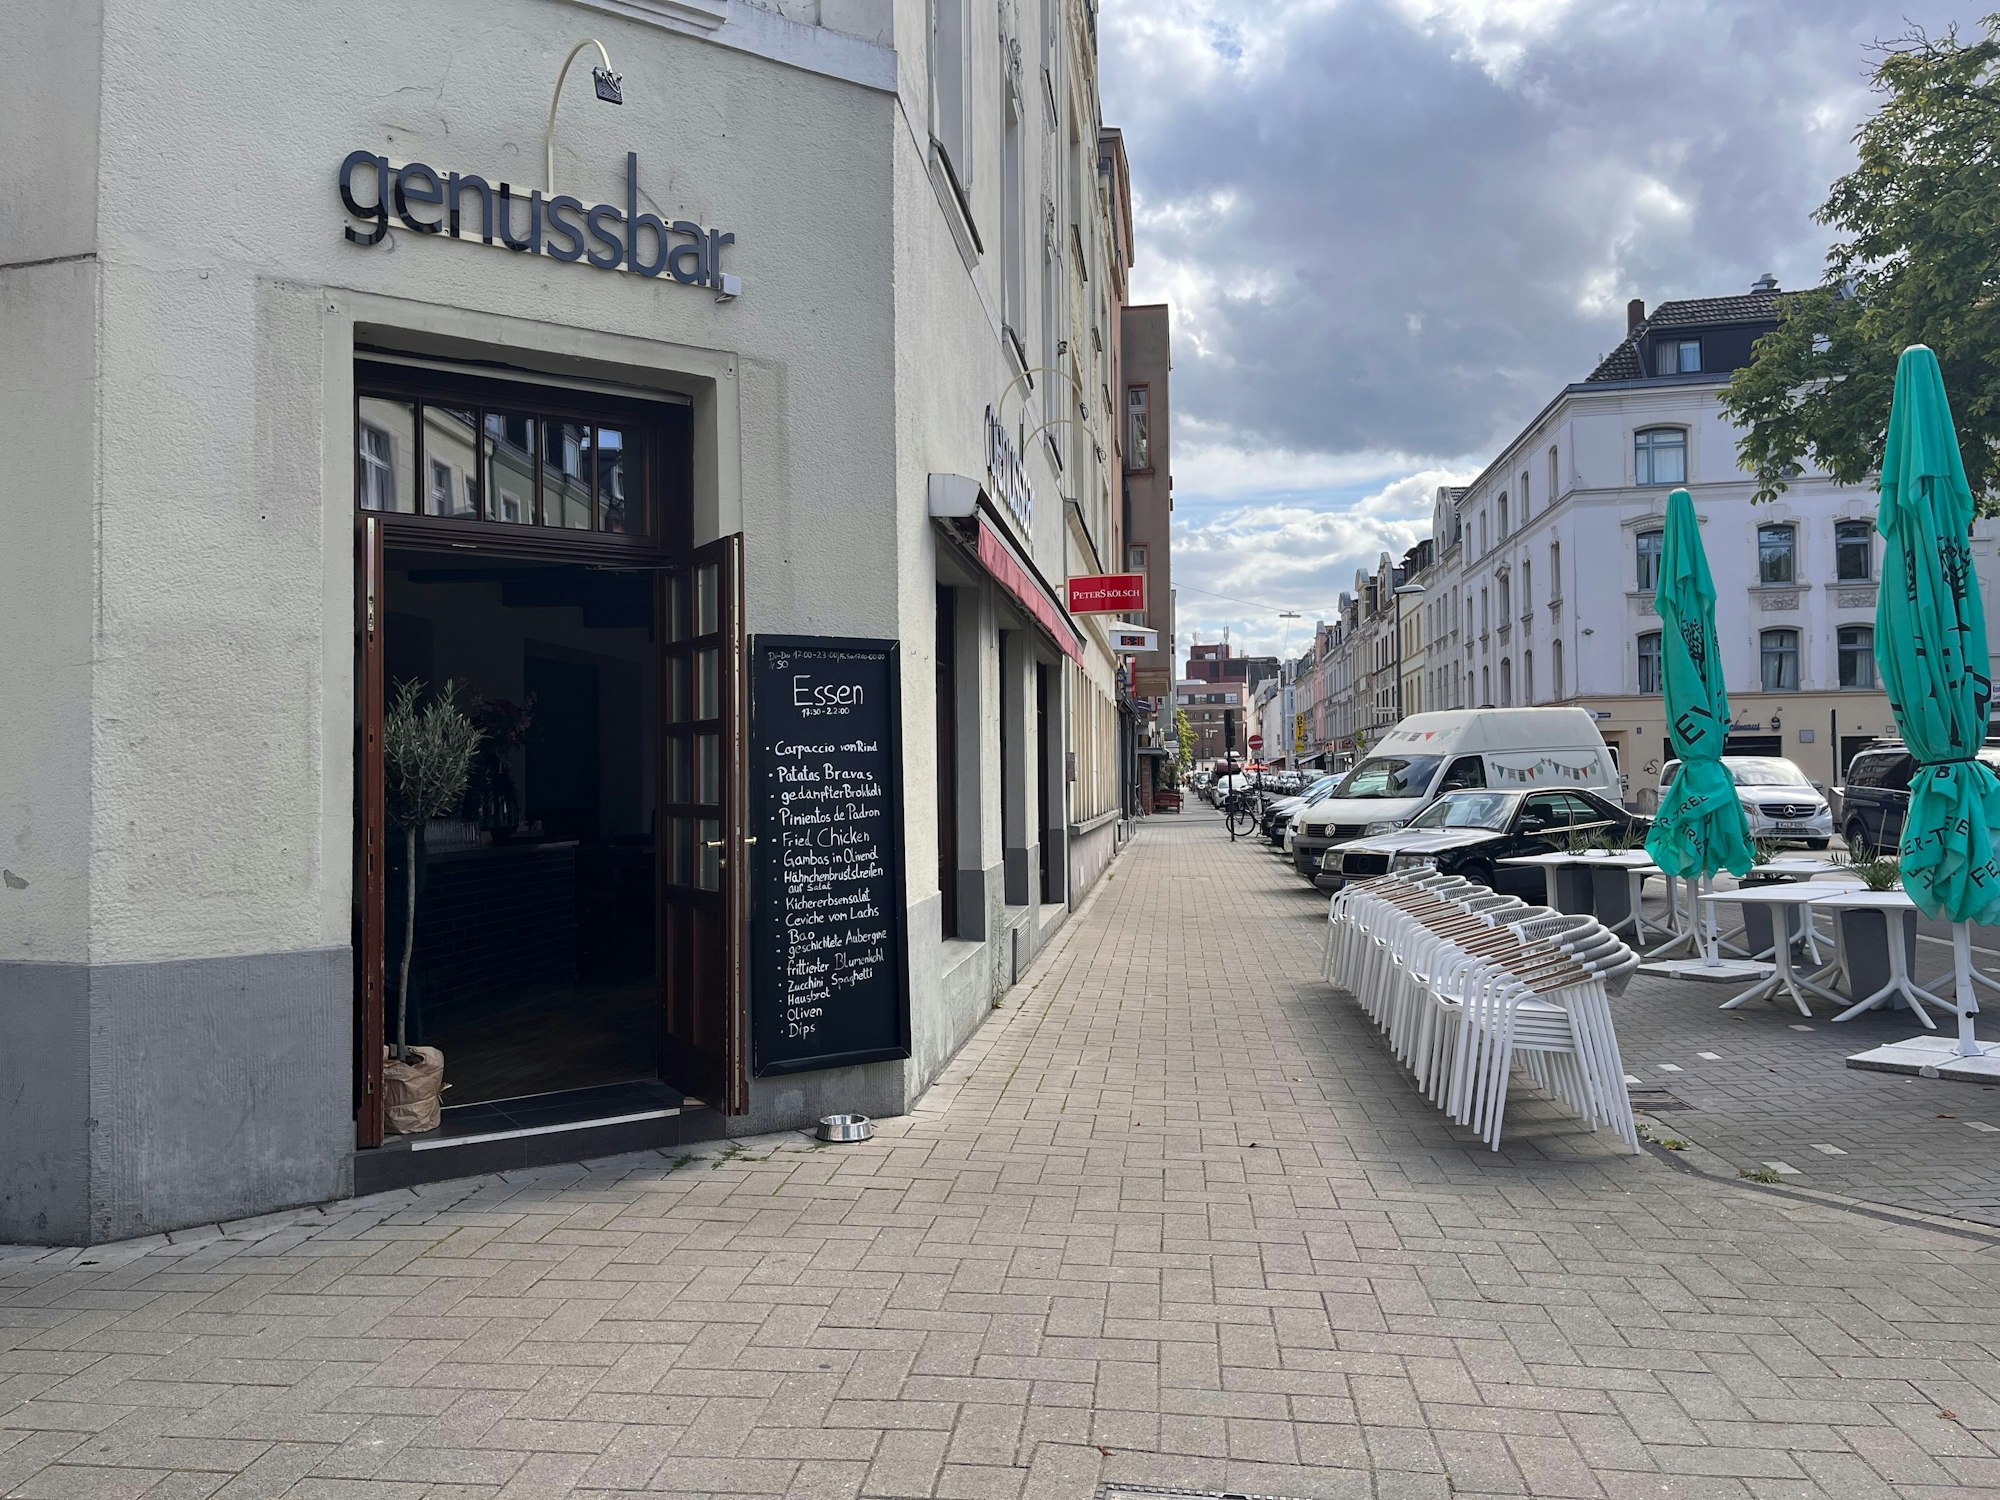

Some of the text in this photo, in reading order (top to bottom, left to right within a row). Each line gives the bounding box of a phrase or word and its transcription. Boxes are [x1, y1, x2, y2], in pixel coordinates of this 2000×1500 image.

[339, 149, 735, 289] genussbar
[793, 674, 864, 706] Essen
[775, 740, 835, 760] Carpaccio
[777, 762, 873, 783] Patatas Bravas
[779, 802, 880, 826] Pimientos de Padron
[782, 825, 870, 848] Fried Chicken
[783, 848, 830, 868] Gambas
[832, 852, 843, 863] in
[785, 887, 872, 911] Kichererbsensalat
[788, 881, 833, 894] auf Salat
[785, 903, 880, 927] Ceviche vom Lachs
[787, 928, 815, 944] Bao
[787, 933, 843, 960] geschichtete
[786, 947, 885, 977] frittierter Blumenkohl
[787, 967, 873, 993] Zucchini Spaghetti
[787, 986, 831, 1006] Hausbrot
[787, 1007, 823, 1022] Oliven
[788, 1021, 816, 1041] Dips
